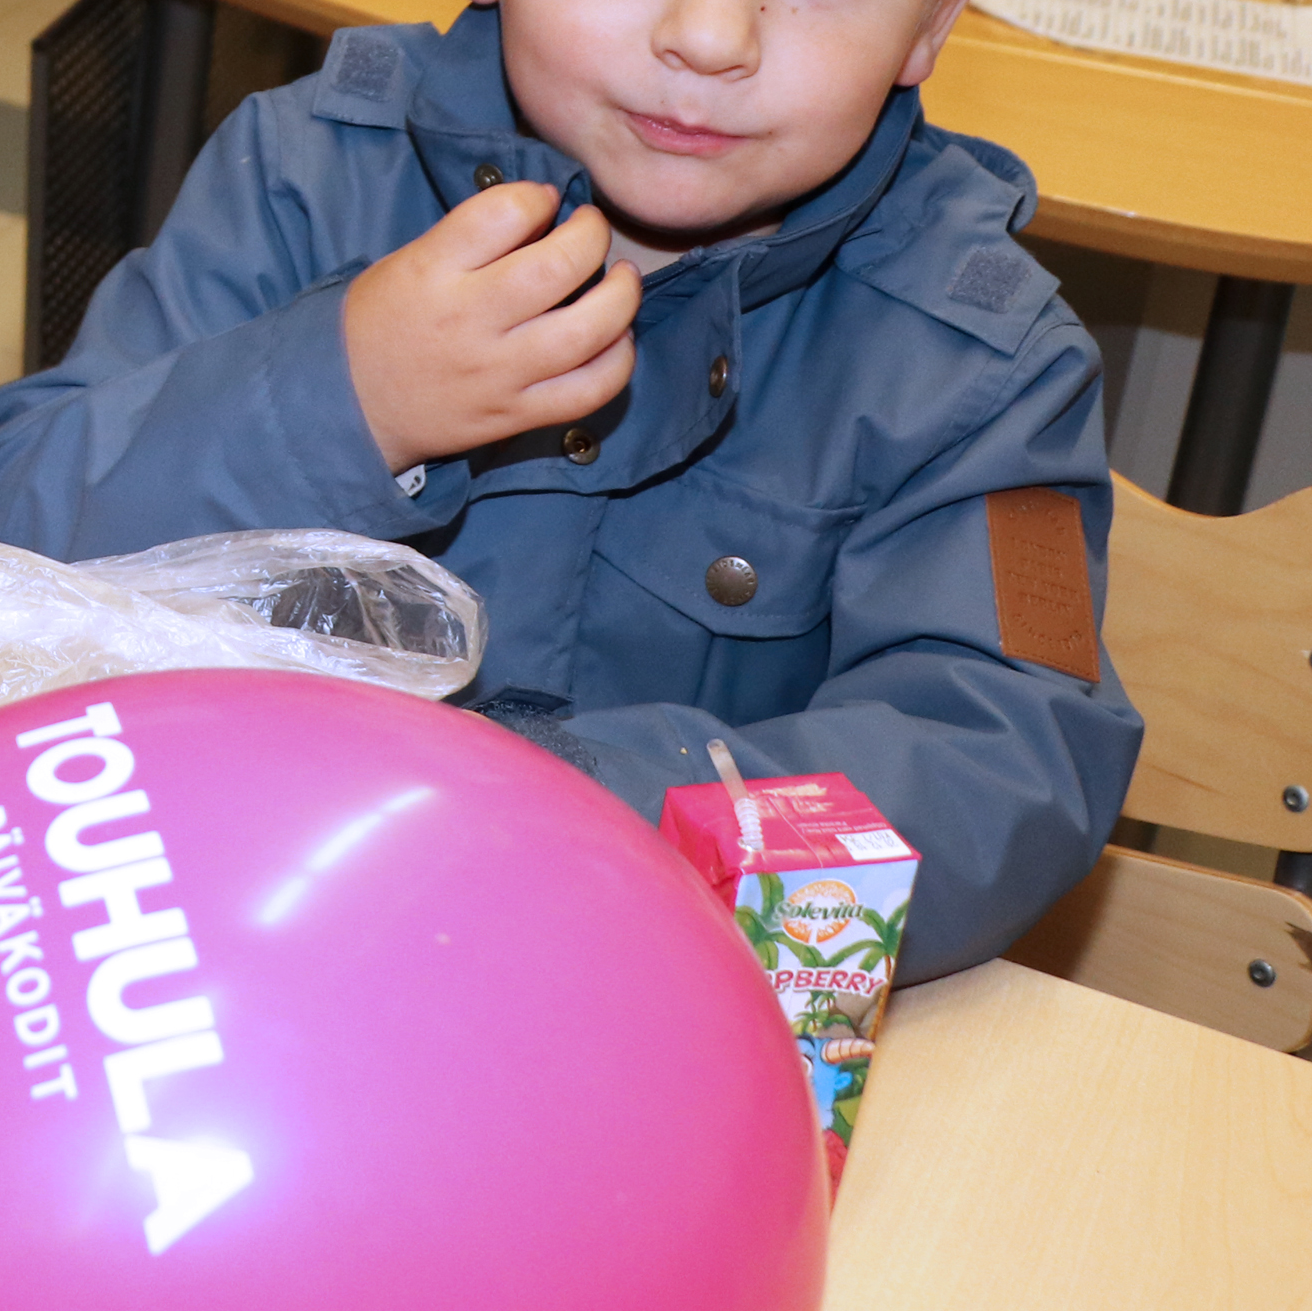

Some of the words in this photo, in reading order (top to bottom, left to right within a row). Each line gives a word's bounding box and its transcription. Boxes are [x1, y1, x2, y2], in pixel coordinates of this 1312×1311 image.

[774, 901, 863, 921] Solevita
[15, 701, 255, 1257] TOUHULA
[769, 970, 884, 994] PBERRY
